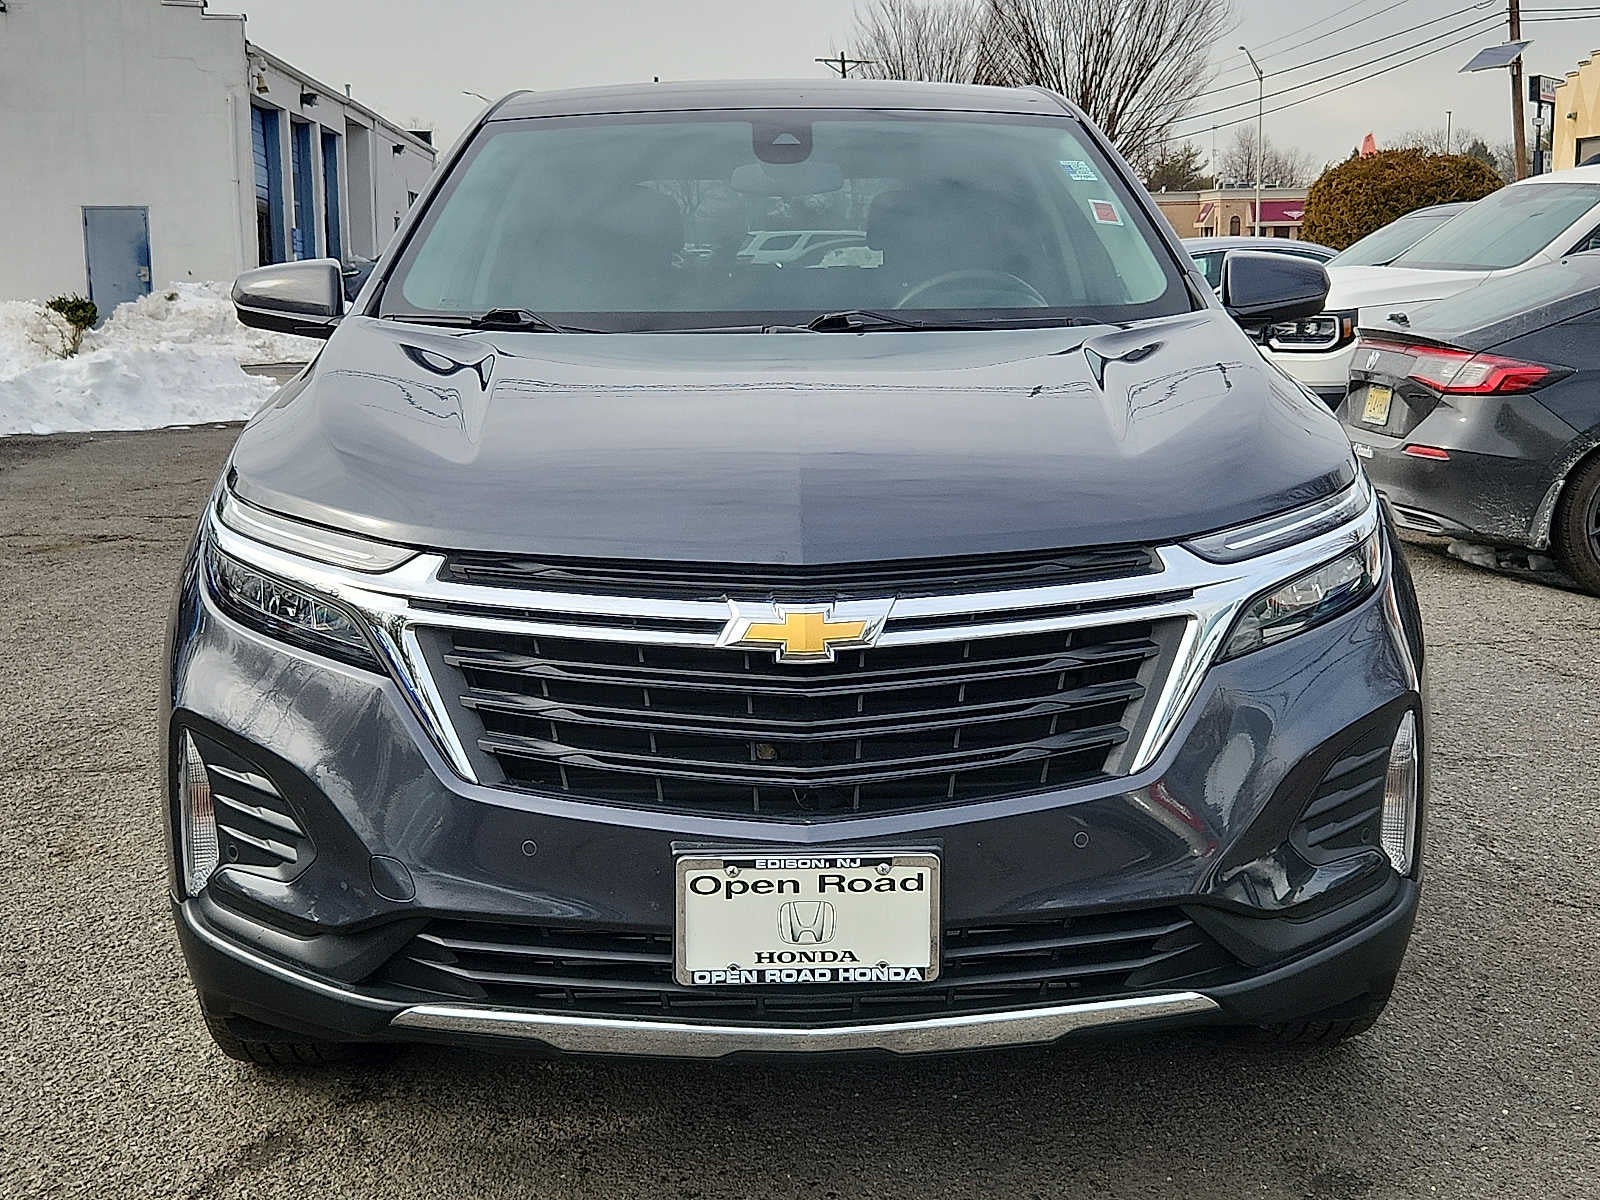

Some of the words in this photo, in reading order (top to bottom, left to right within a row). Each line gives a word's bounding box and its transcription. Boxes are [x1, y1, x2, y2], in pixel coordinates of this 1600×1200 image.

[755, 858, 830, 869] EDISON,
[836, 858, 862, 868] NJ
[689, 874, 800, 899] Open
[818, 872, 924, 893] Road
[754, 950, 860, 964] HONDA
[693, 970, 757, 984] OPEN
[765, 969, 831, 983] ROAD
[838, 967, 922, 982] HONDA
